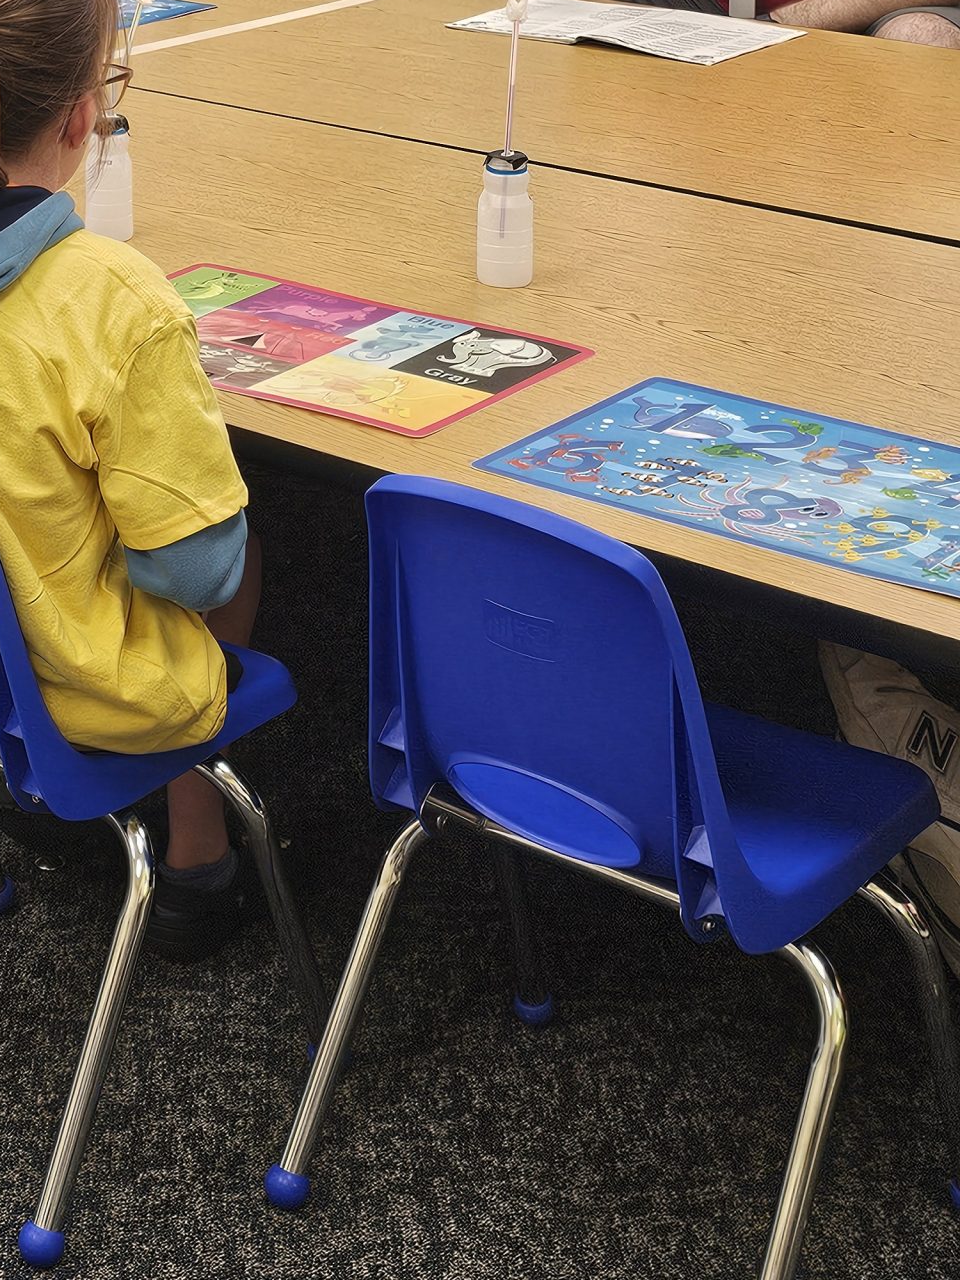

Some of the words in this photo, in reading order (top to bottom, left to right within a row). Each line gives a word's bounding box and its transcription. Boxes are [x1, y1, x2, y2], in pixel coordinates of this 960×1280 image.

[276, 285, 340, 305] Purple
[407, 315, 456, 330] Blue
[423, 368, 479, 385] Gray
[907, 710, 959, 774] N
